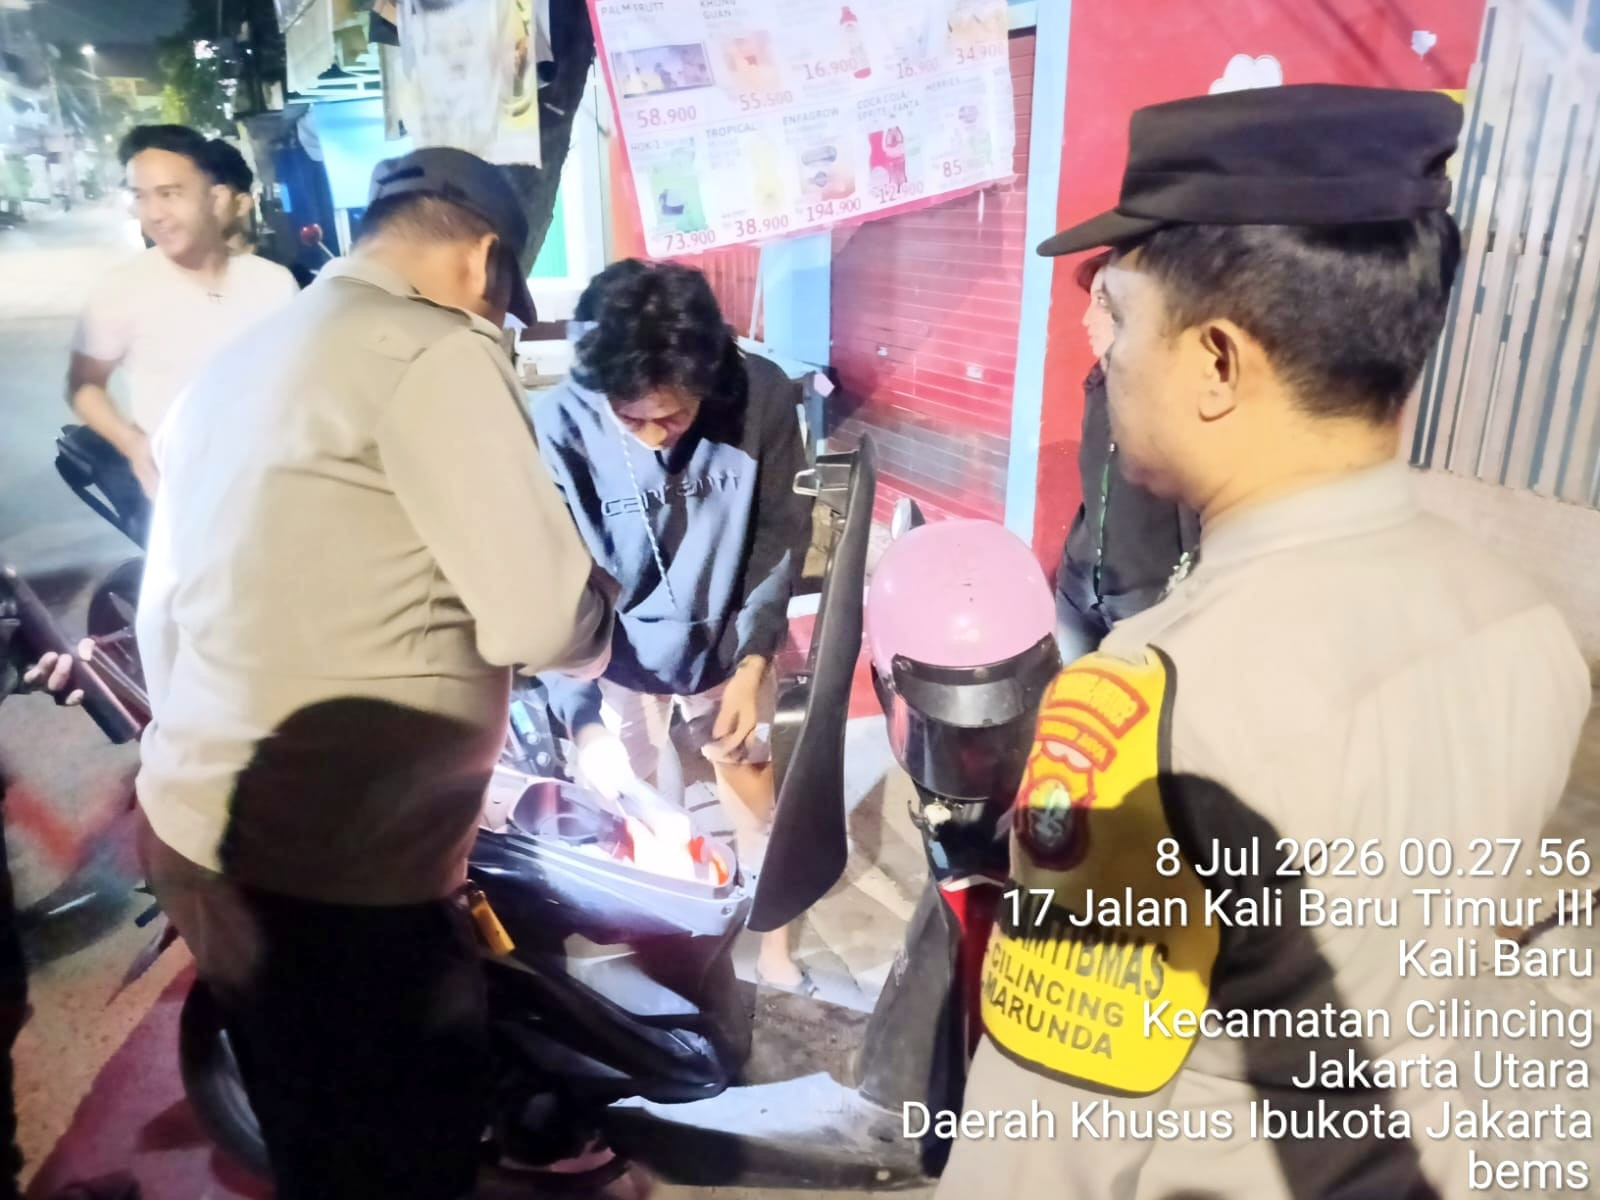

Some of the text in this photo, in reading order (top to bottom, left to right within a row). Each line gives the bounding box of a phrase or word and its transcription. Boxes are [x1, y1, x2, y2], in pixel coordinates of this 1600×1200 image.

[802, 57, 859, 81] 16.900
[637, 105, 697, 129] 58.900
[806, 197, 862, 223] 194.900
[734, 214, 790, 238] 38.900
[663, 229, 717, 252] 73.900
[990, 942, 1124, 1028] CILINCING
[984, 970, 1112, 1060] MARUNDA
